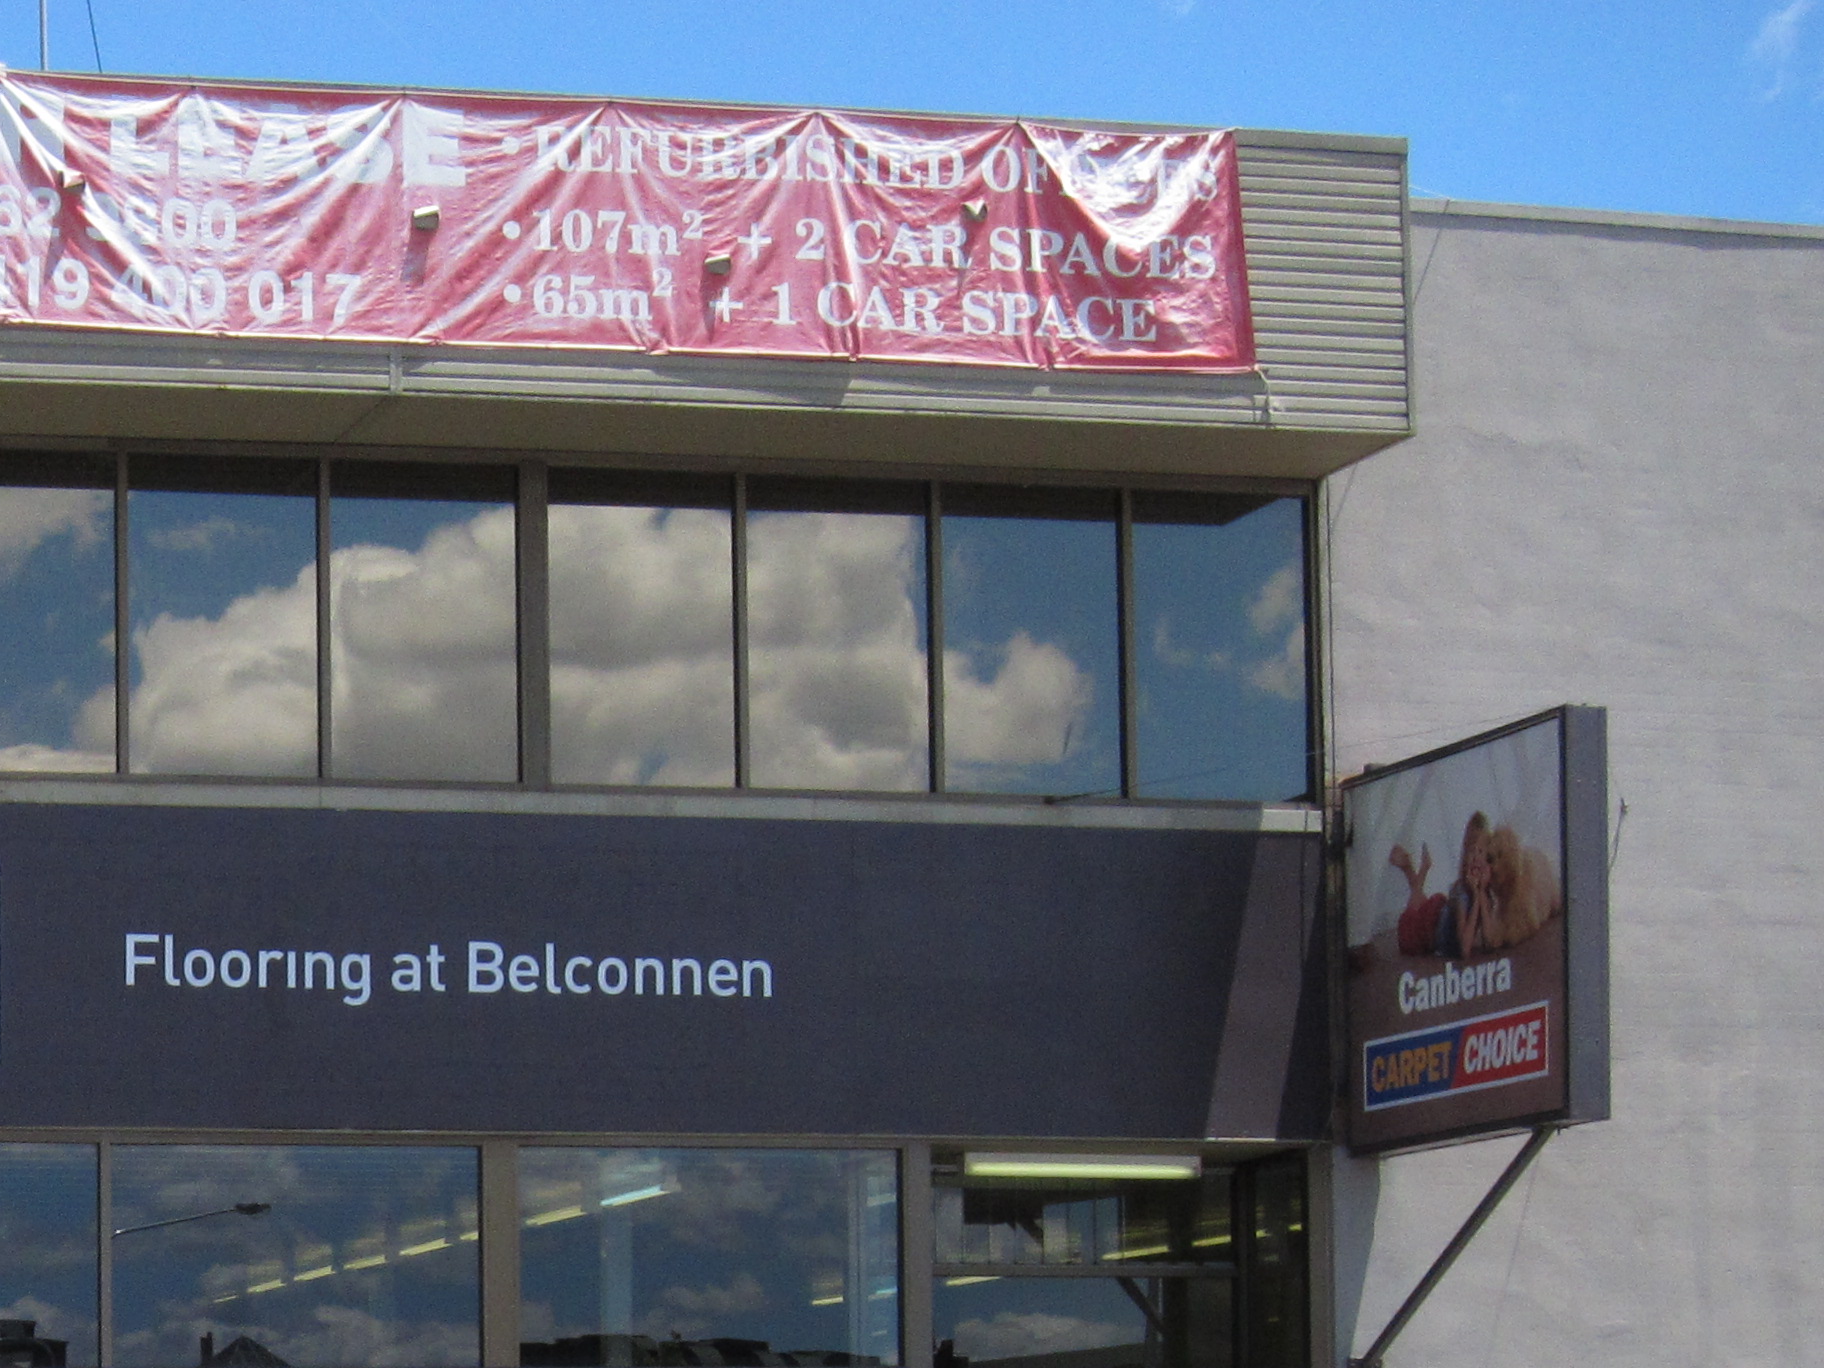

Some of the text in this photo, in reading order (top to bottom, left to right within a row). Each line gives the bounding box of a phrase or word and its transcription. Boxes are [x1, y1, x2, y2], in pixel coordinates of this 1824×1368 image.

[110, 96, 467, 188] LEASE
[535, 124, 965, 189] REFURBISHED
[737, 222, 772, 261] +
[795, 218, 826, 260] 2
[848, 219, 971, 270] CAR
[989, 226, 1217, 280] SPACES
[248, 268, 362, 332] 017
[709, 286, 744, 323] +
[770, 282, 797, 325] 1
[817, 281, 944, 333] CAR
[961, 290, 1157, 342] SPACE
[125, 933, 773, 1006] Flooring at Belconnen
[1398, 957, 1512, 1015] Canberra
[1371, 1018, 1542, 1093] CARPET CHOICE
